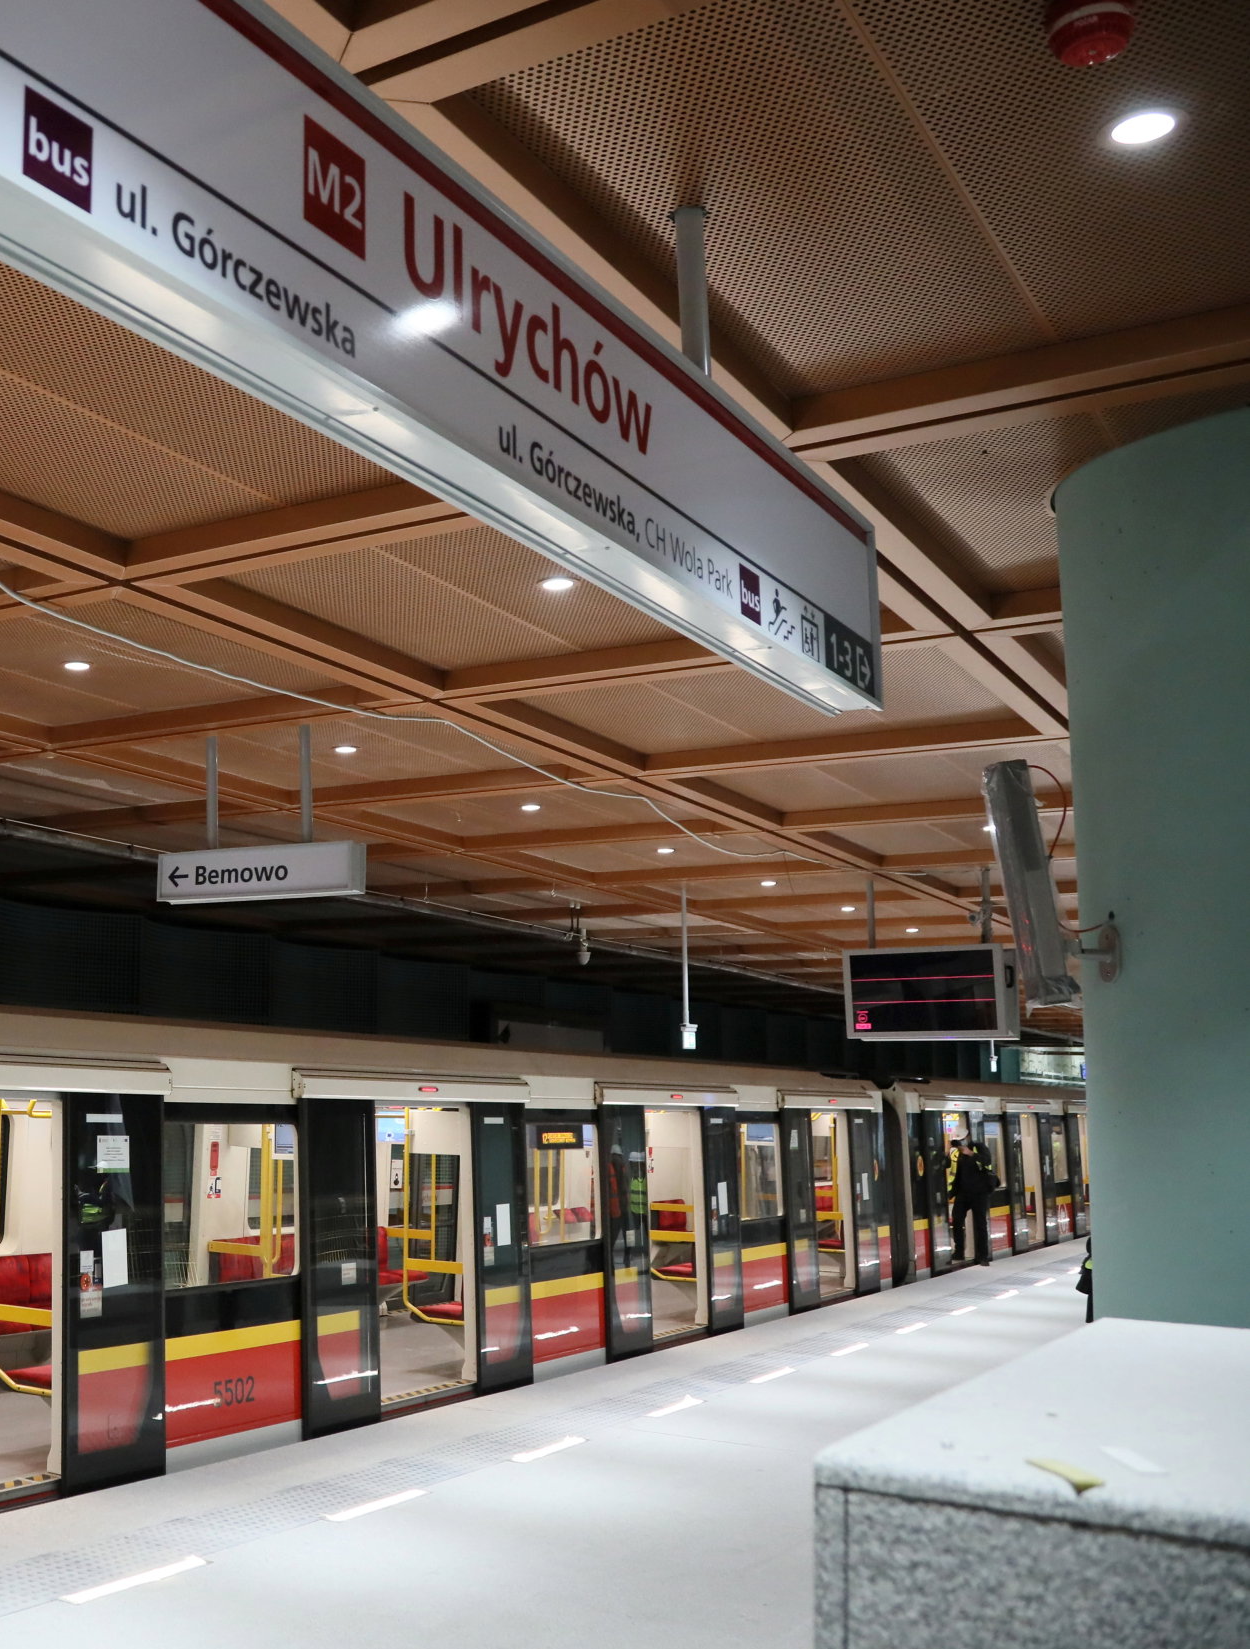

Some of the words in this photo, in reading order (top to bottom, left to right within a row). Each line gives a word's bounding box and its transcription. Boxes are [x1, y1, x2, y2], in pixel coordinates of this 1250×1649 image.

[29, 115, 90, 187] bus
[116, 182, 158, 237] ul.
[172, 212, 356, 358] Górczewska
[308, 146, 363, 231] M2
[404, 190, 652, 456] Ulrychów
[498, 424, 523, 464] ul.
[530, 441, 640, 543] Górczewska,
[645, 517, 667, 556] CH
[671, 532, 704, 581] Wola
[708, 558, 734, 599] Park
[741, 579, 761, 613] bus
[830, 632, 853, 677] 1-3
[194, 864, 288, 886] Bemowo
[213, 1375, 255, 1408] 5502
